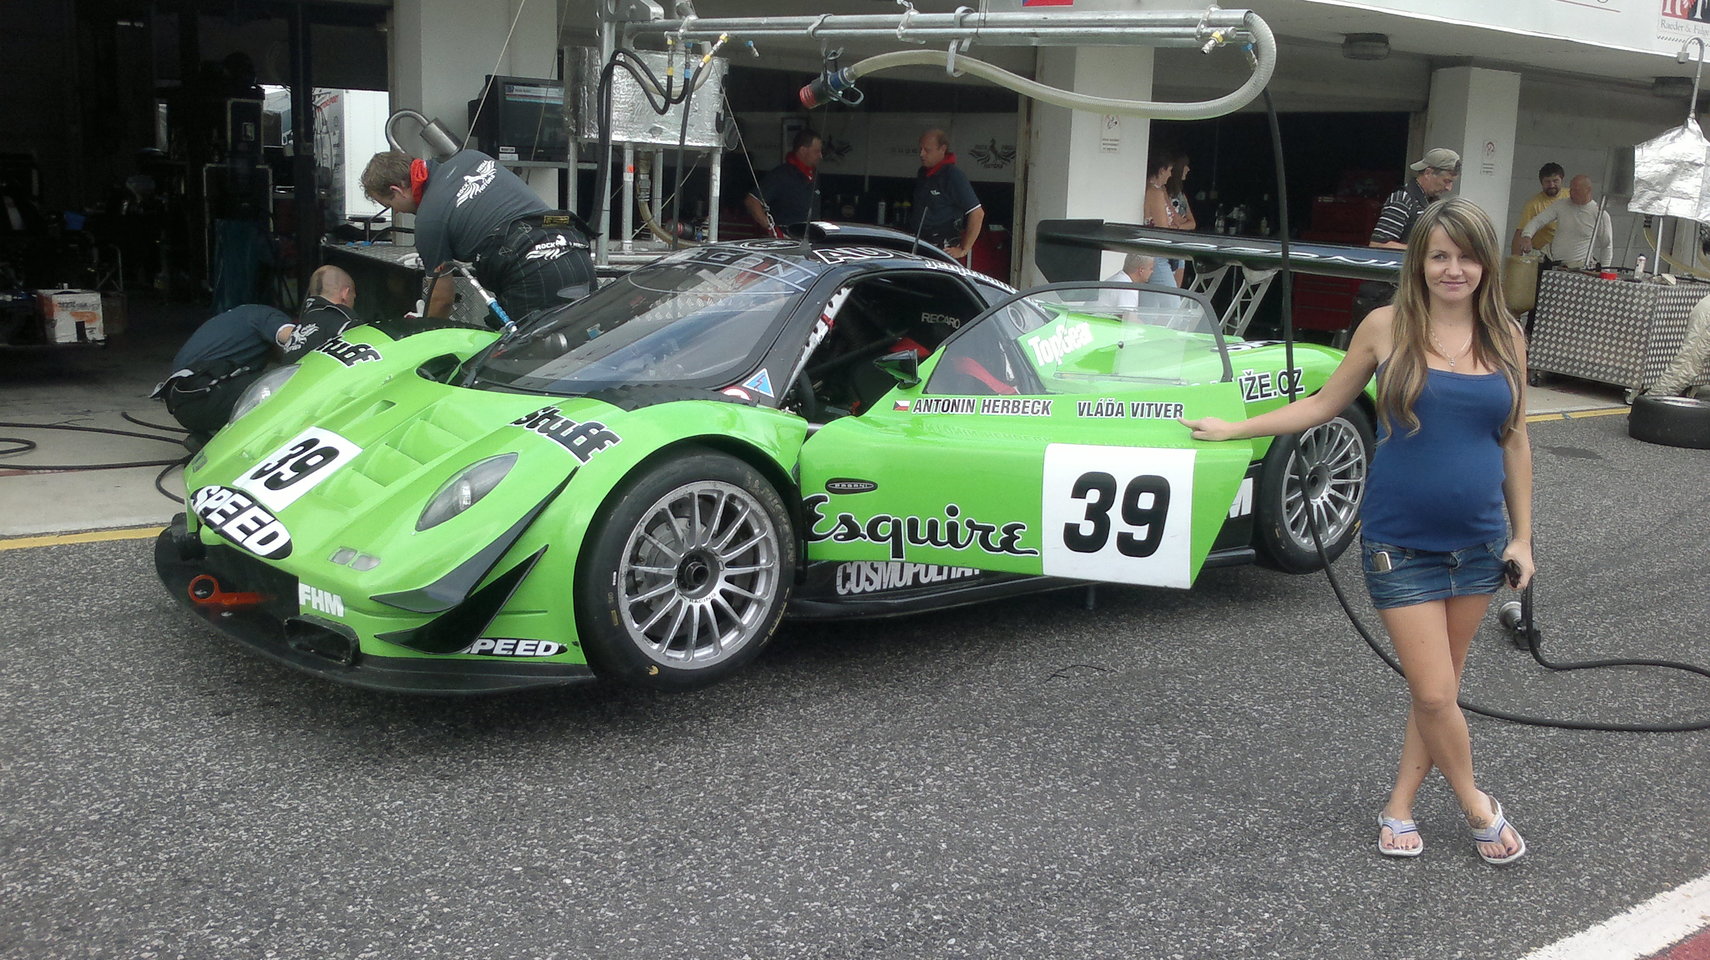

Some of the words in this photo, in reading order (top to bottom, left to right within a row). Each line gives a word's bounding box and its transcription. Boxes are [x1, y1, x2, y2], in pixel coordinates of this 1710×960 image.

[921, 312, 961, 330] RECARO
[1027, 321, 1094, 367] TopGear
[912, 398, 976, 414] ANTONIN
[980, 398, 1052, 416] HERBECK
[1077, 398, 1126, 417] VLÁĎA
[1130, 402, 1184, 419] VITVER
[250, 437, 341, 491] 39
[186, 484, 292, 557] SPEED
[802, 493, 1040, 561] Esquire
[1062, 470, 1171, 558] 39
[299, 582, 345, 618] FHM
[461, 638, 560, 657] PEED
